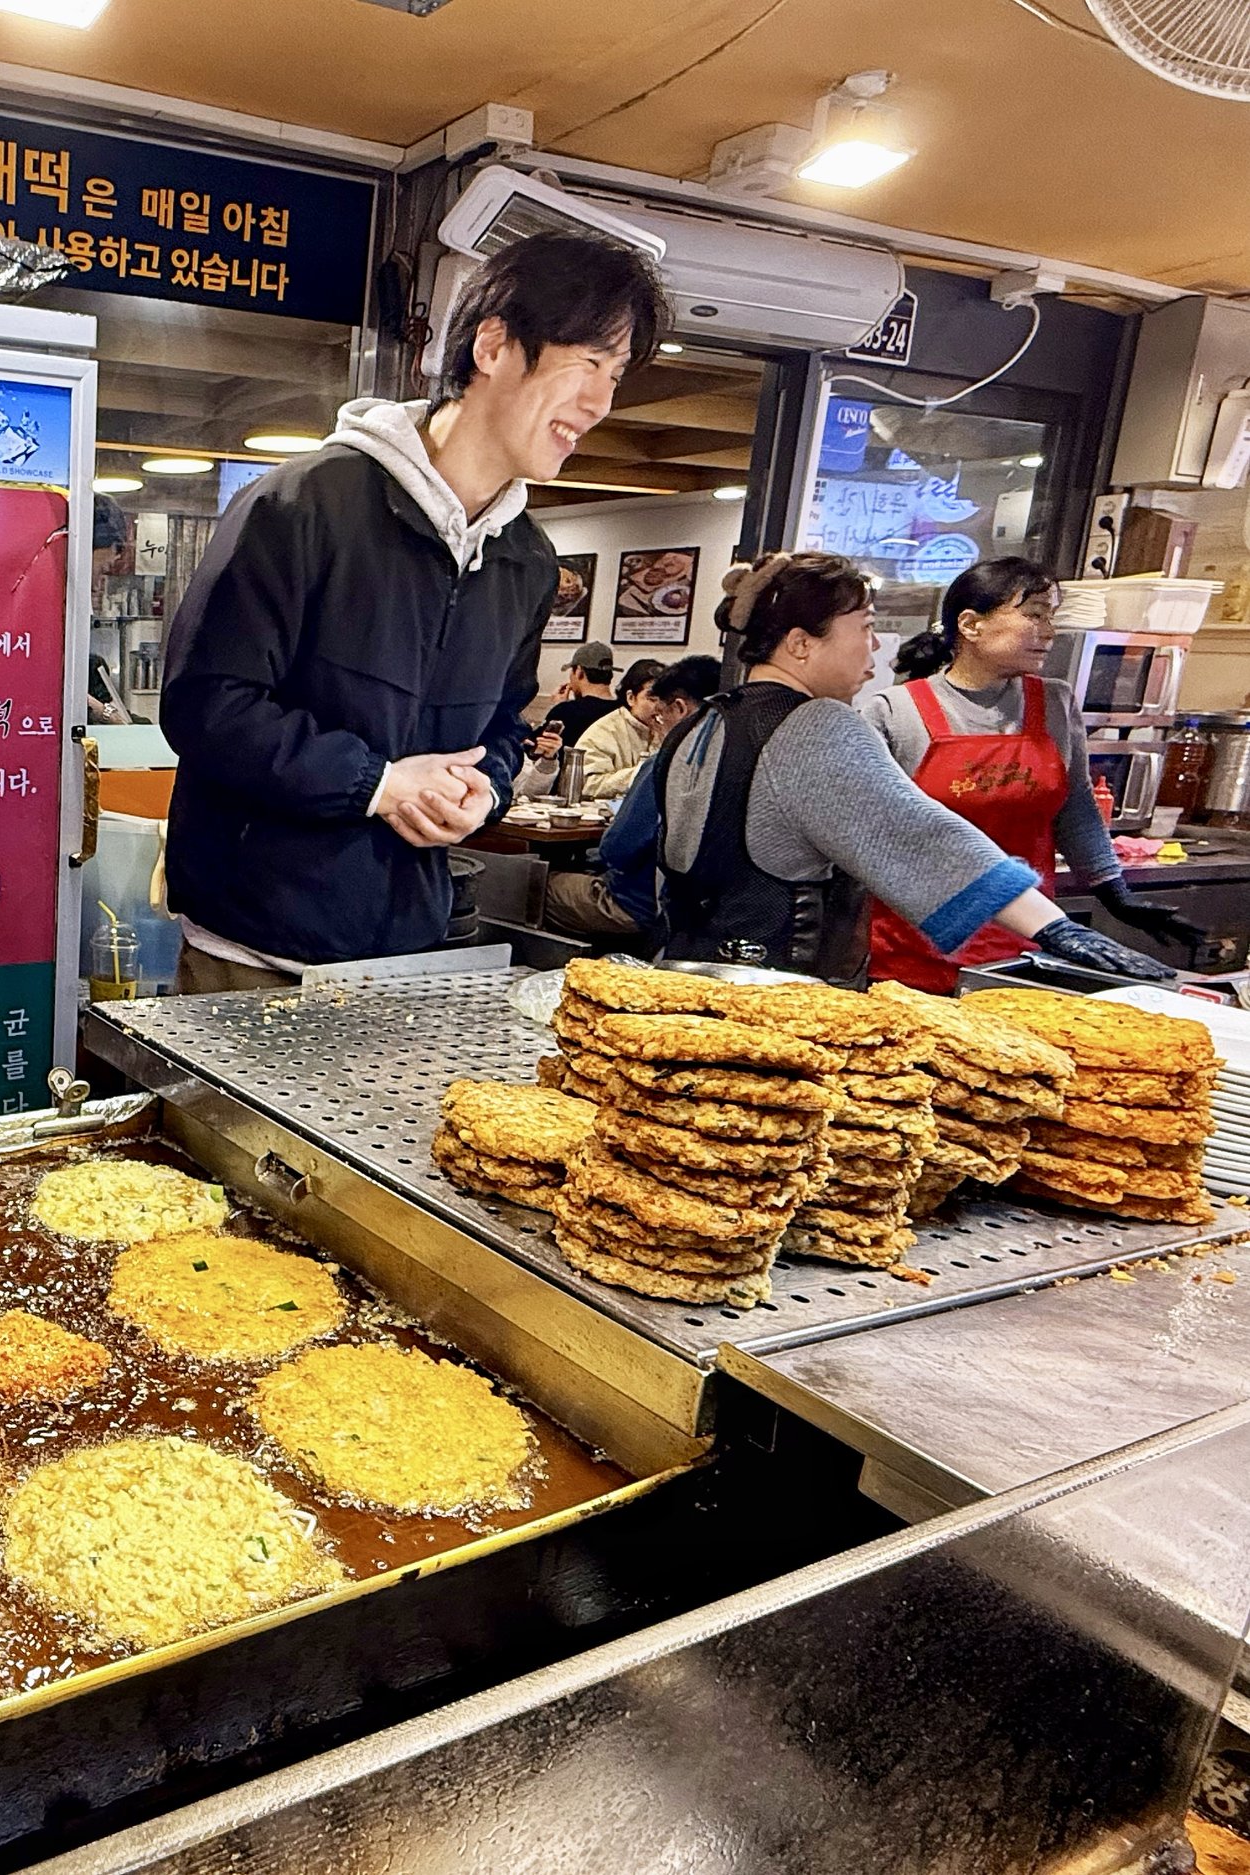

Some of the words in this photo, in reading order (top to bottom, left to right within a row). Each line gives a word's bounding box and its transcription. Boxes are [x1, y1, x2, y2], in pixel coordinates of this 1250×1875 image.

[140, 188, 212, 233] 매일
[222, 202, 290, 249] 아침
[170, 247, 290, 302] 있습니다
